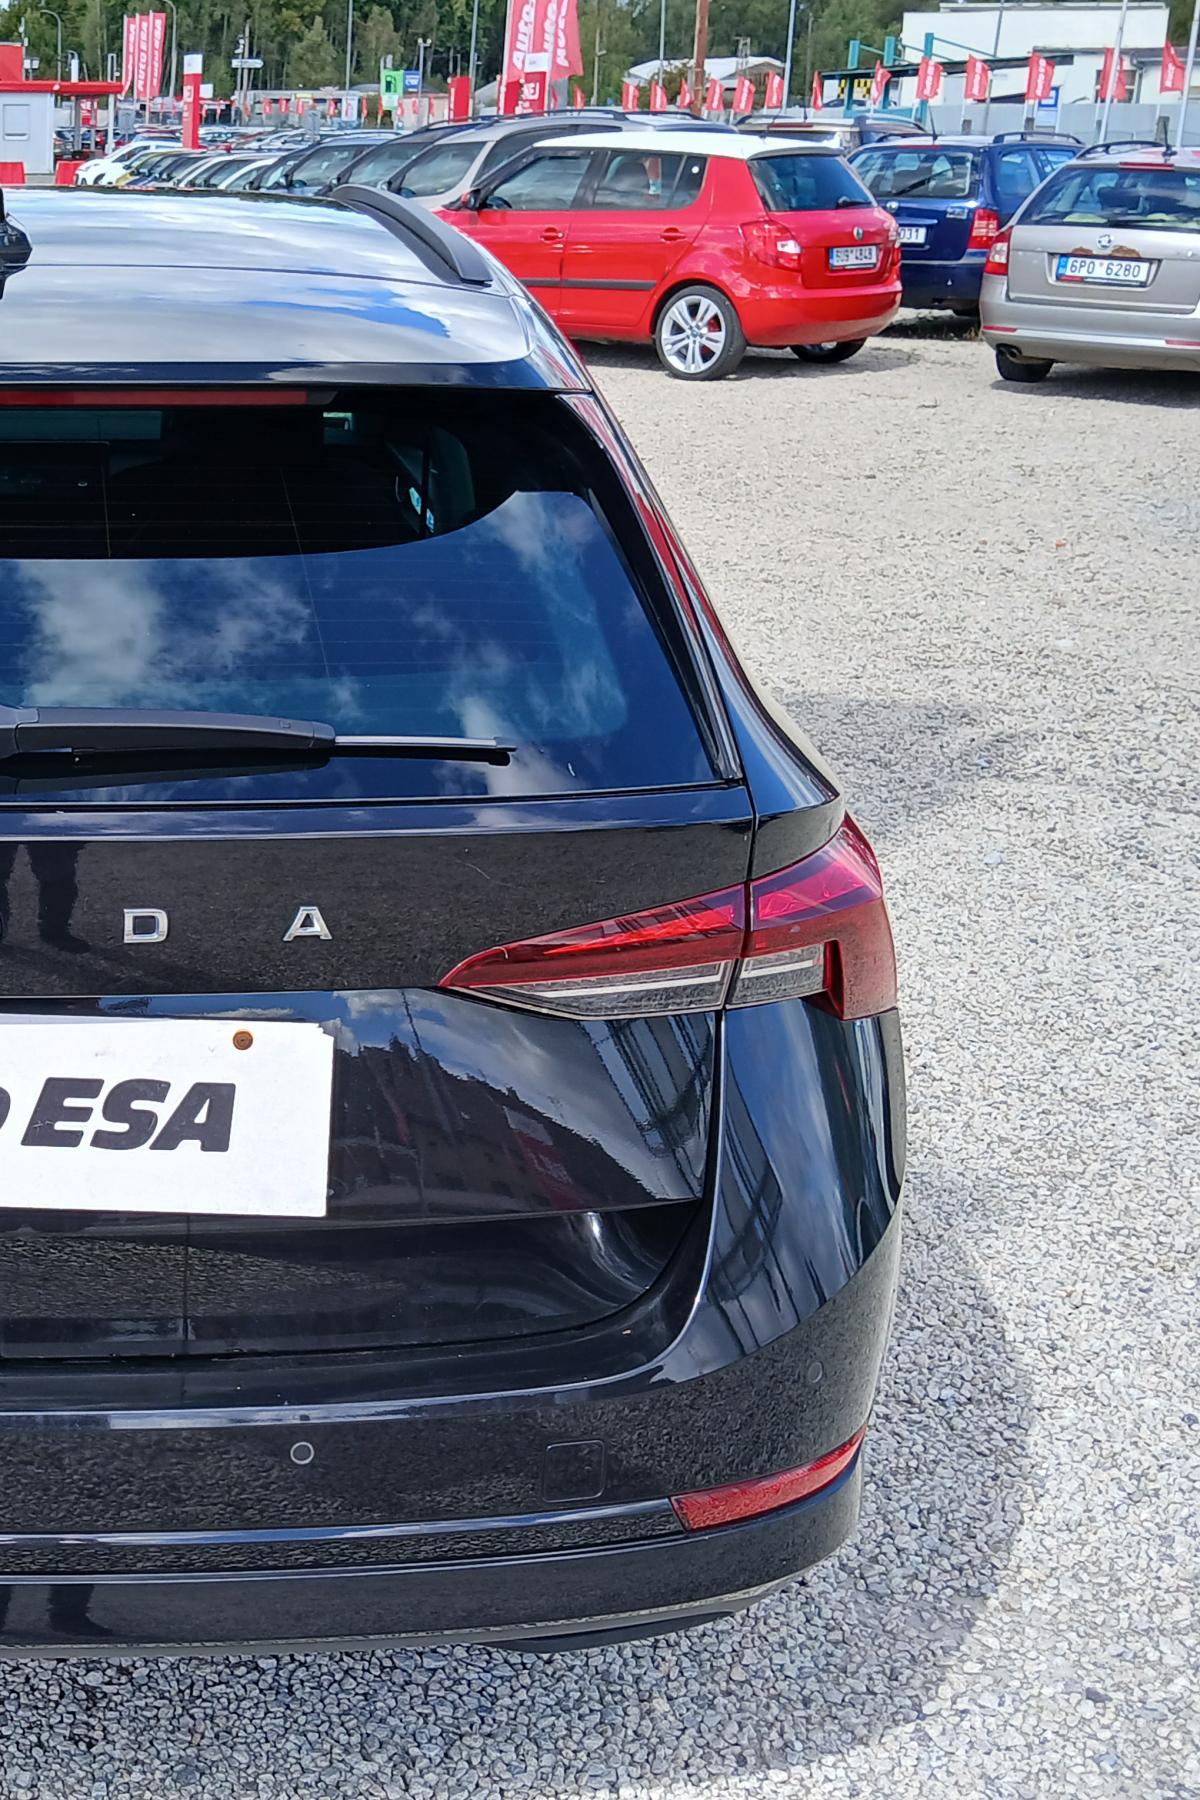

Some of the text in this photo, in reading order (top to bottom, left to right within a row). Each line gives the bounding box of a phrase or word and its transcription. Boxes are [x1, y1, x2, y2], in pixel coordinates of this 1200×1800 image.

[1070, 259, 1096, 275] 6P0
[1105, 262, 1141, 278] 6280
[20, 1076, 237, 1153] ESA
